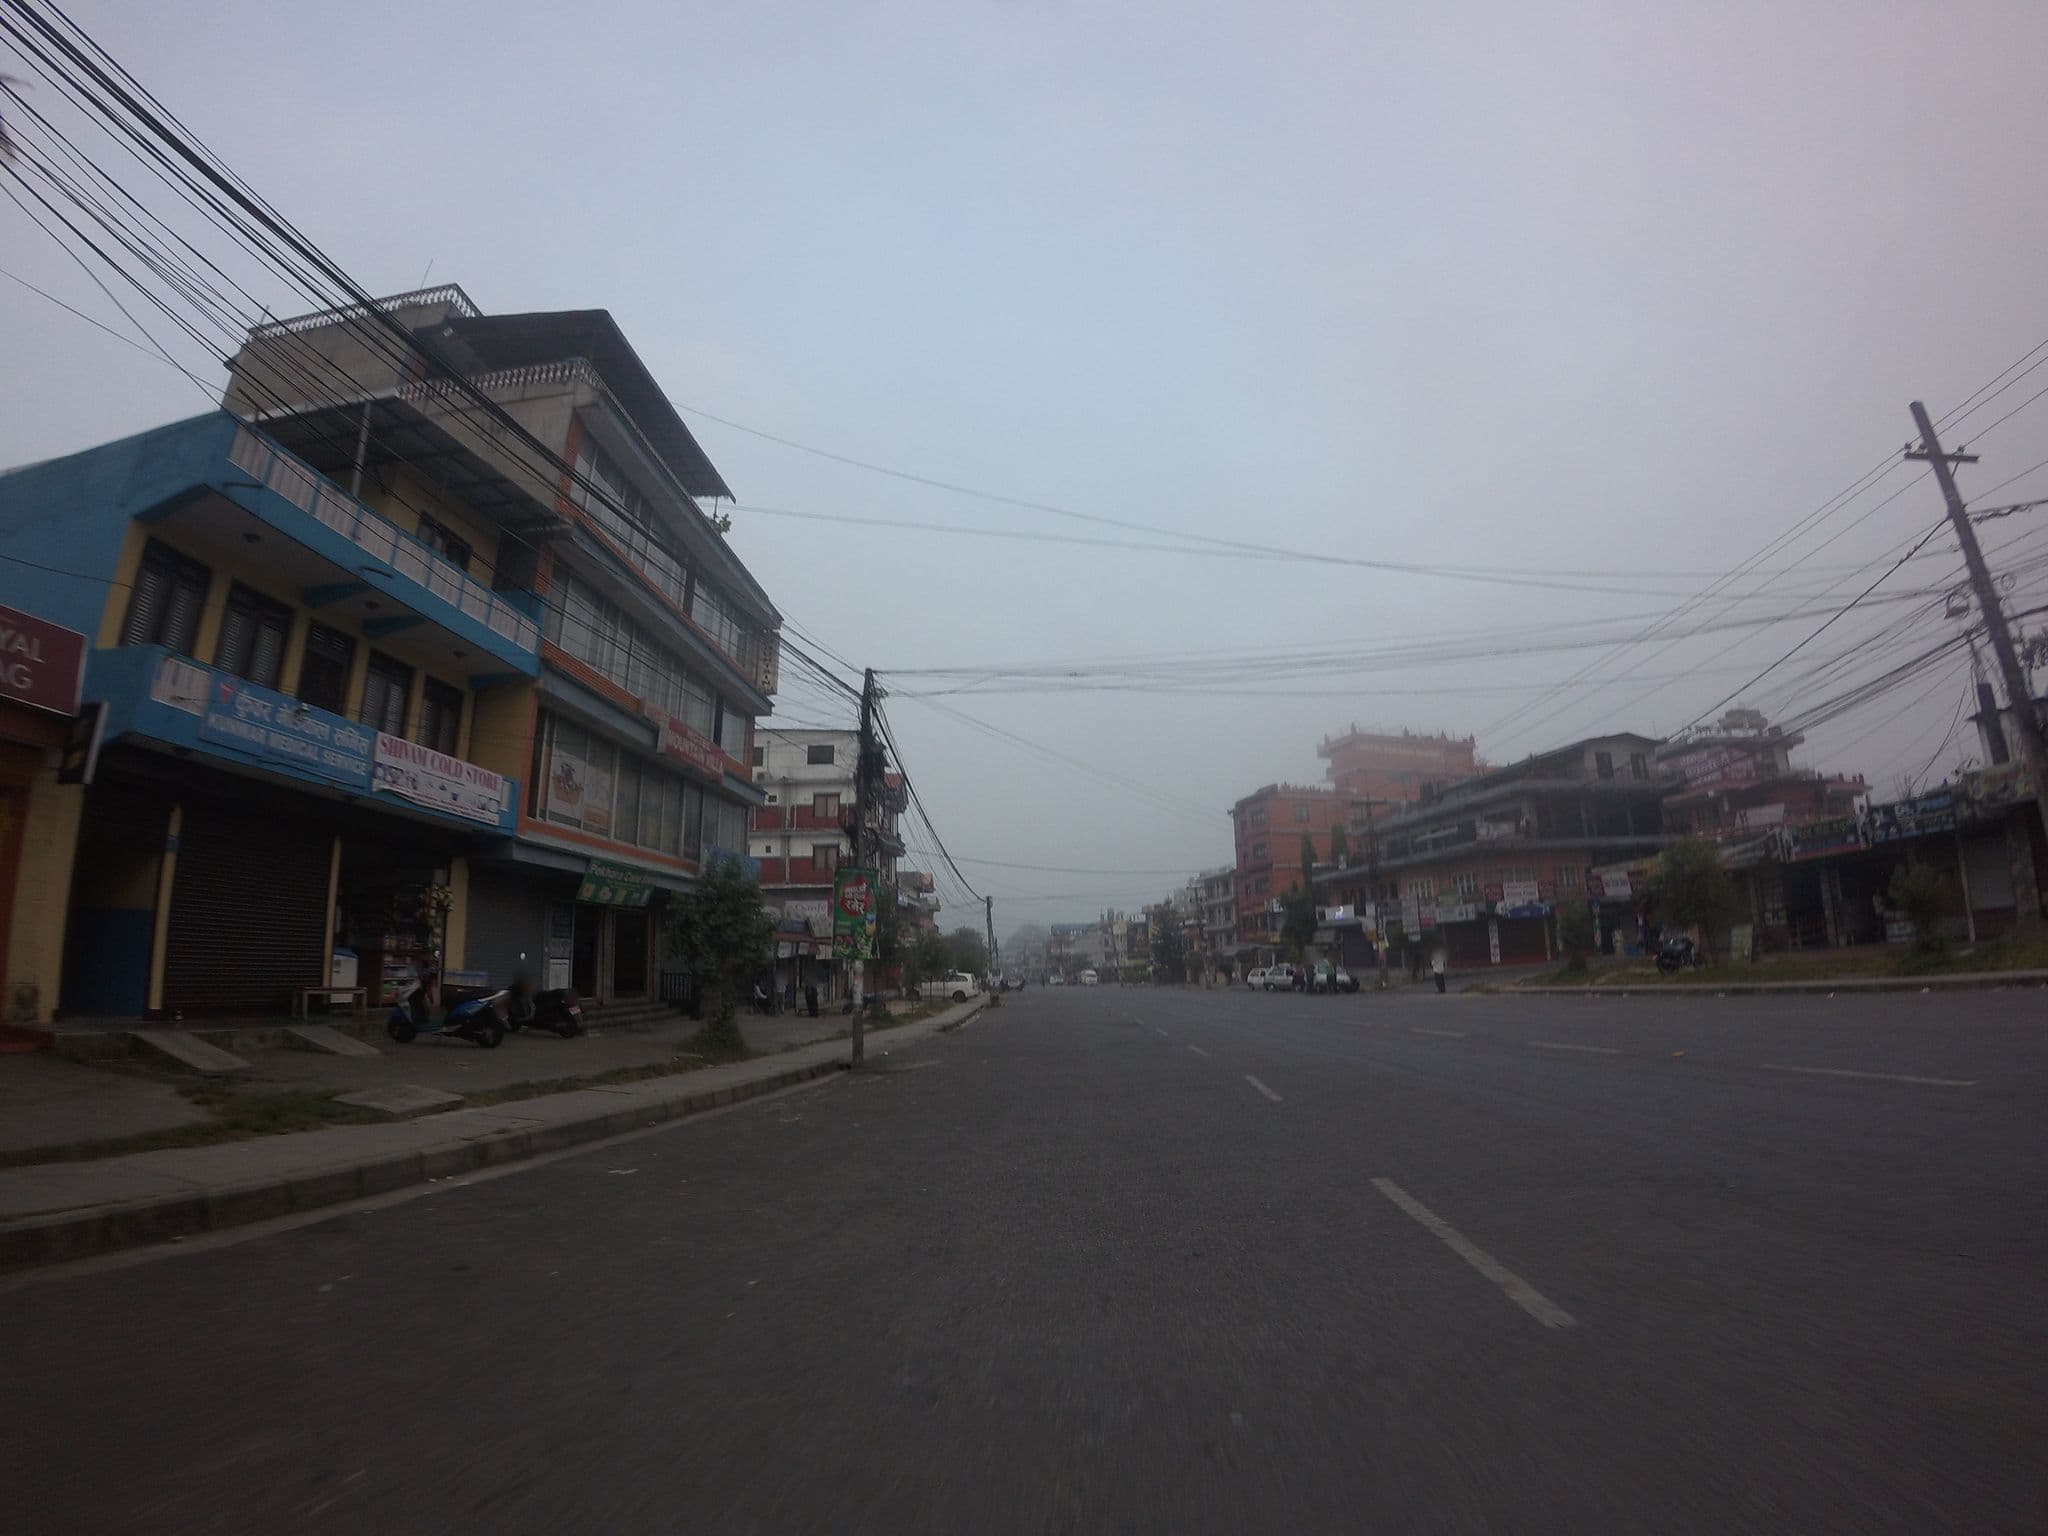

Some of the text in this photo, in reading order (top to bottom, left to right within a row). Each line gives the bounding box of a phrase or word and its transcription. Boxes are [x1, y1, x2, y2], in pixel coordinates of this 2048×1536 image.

[269, 730, 320, 762] MEDICAL
[322, 747, 368, 777] SERVICE
[379, 735, 499, 792] SHIVAM COLD STORE
